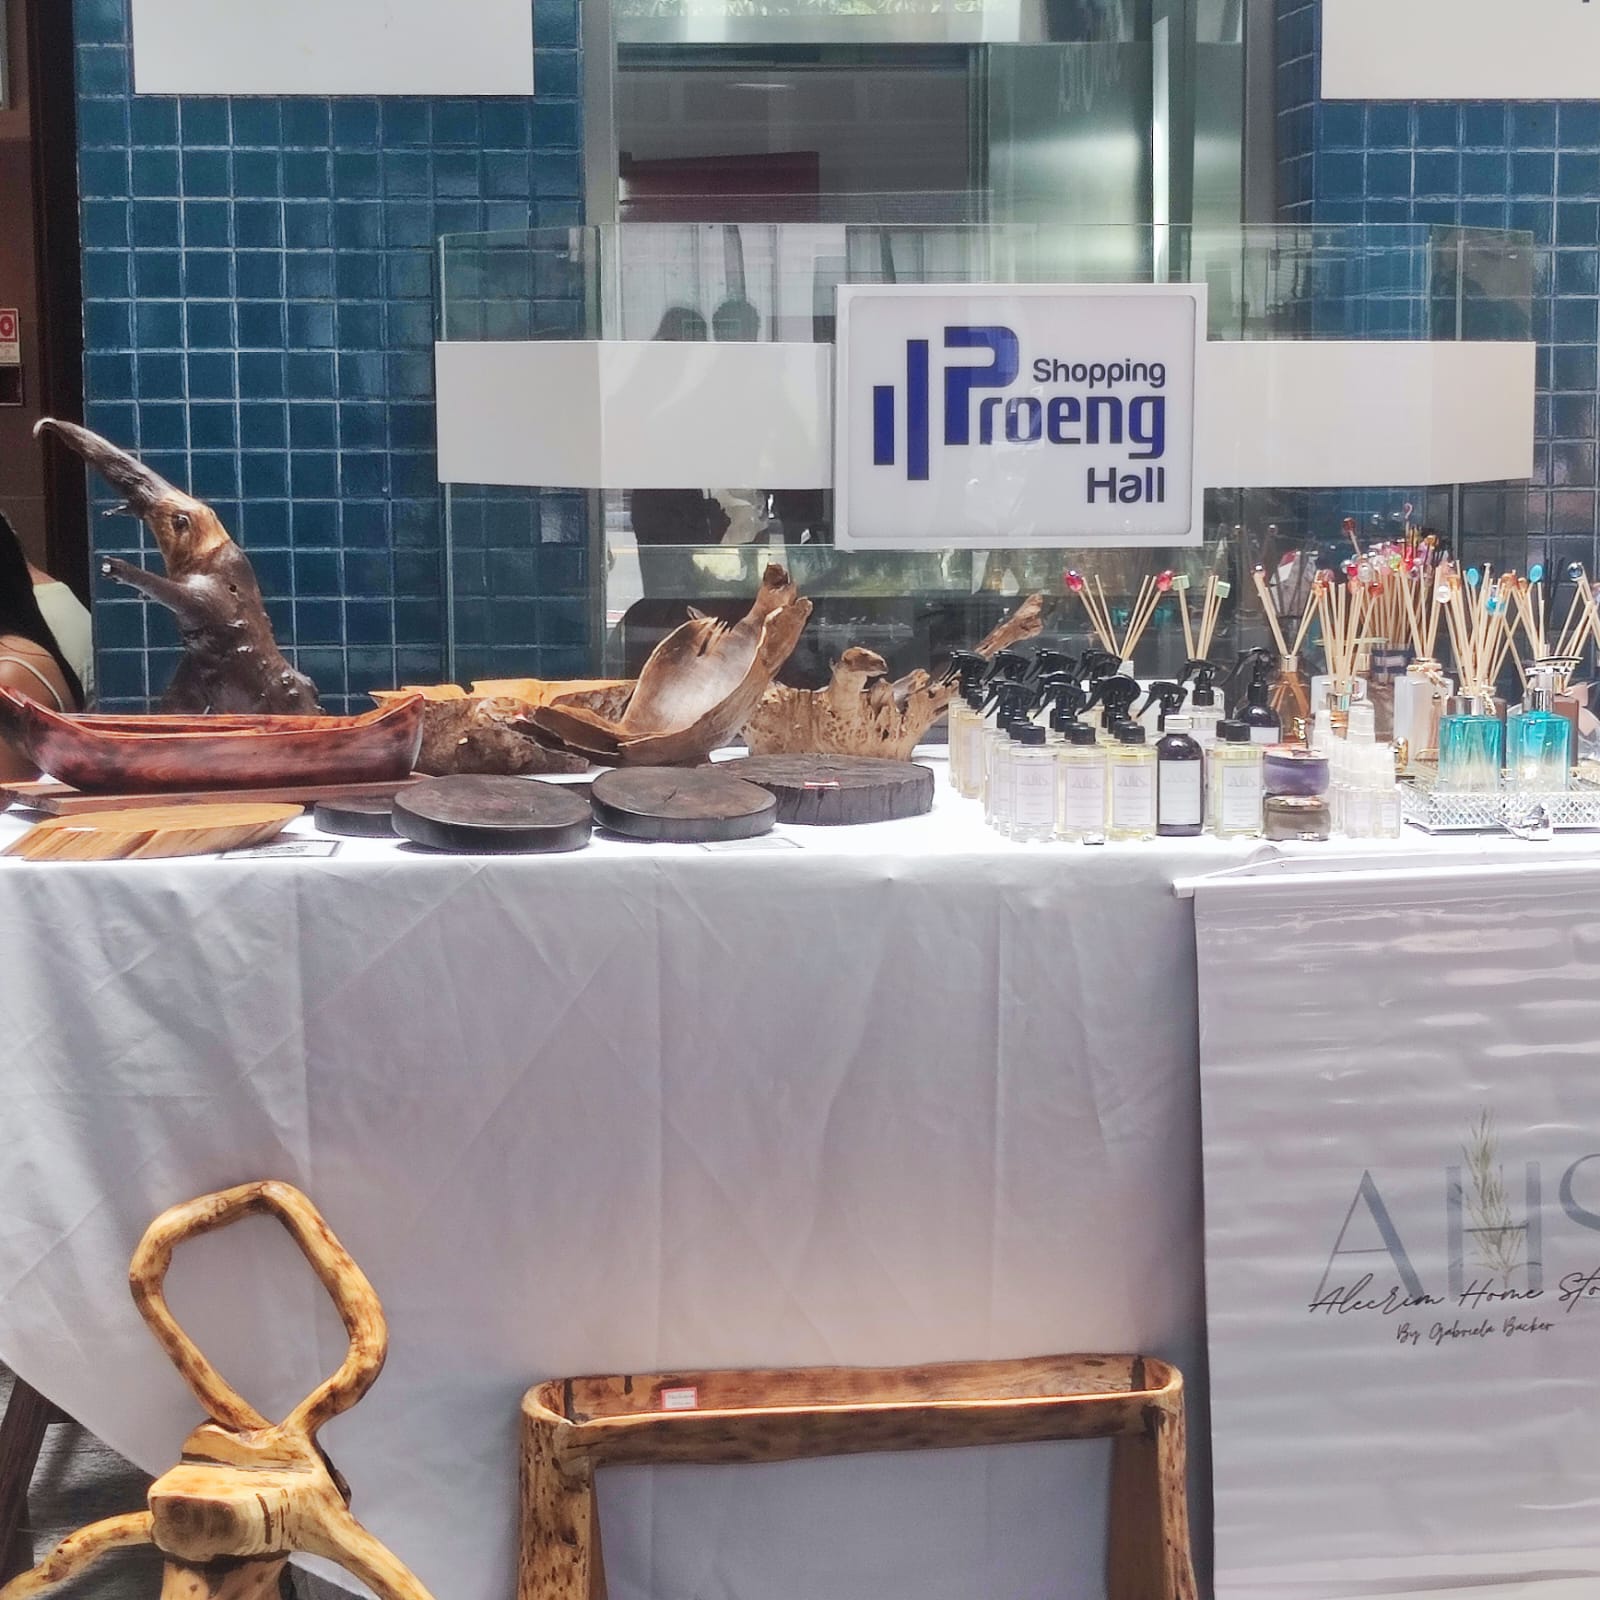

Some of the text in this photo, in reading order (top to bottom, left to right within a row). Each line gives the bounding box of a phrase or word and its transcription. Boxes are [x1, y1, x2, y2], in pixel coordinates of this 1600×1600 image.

[1032, 358, 1166, 389] Shopping
[944, 326, 1165, 460] Proeng
[1086, 466, 1165, 504] Hall
[1458, 1278, 1543, 1310] Home
[1396, 1323, 1421, 1346] By
